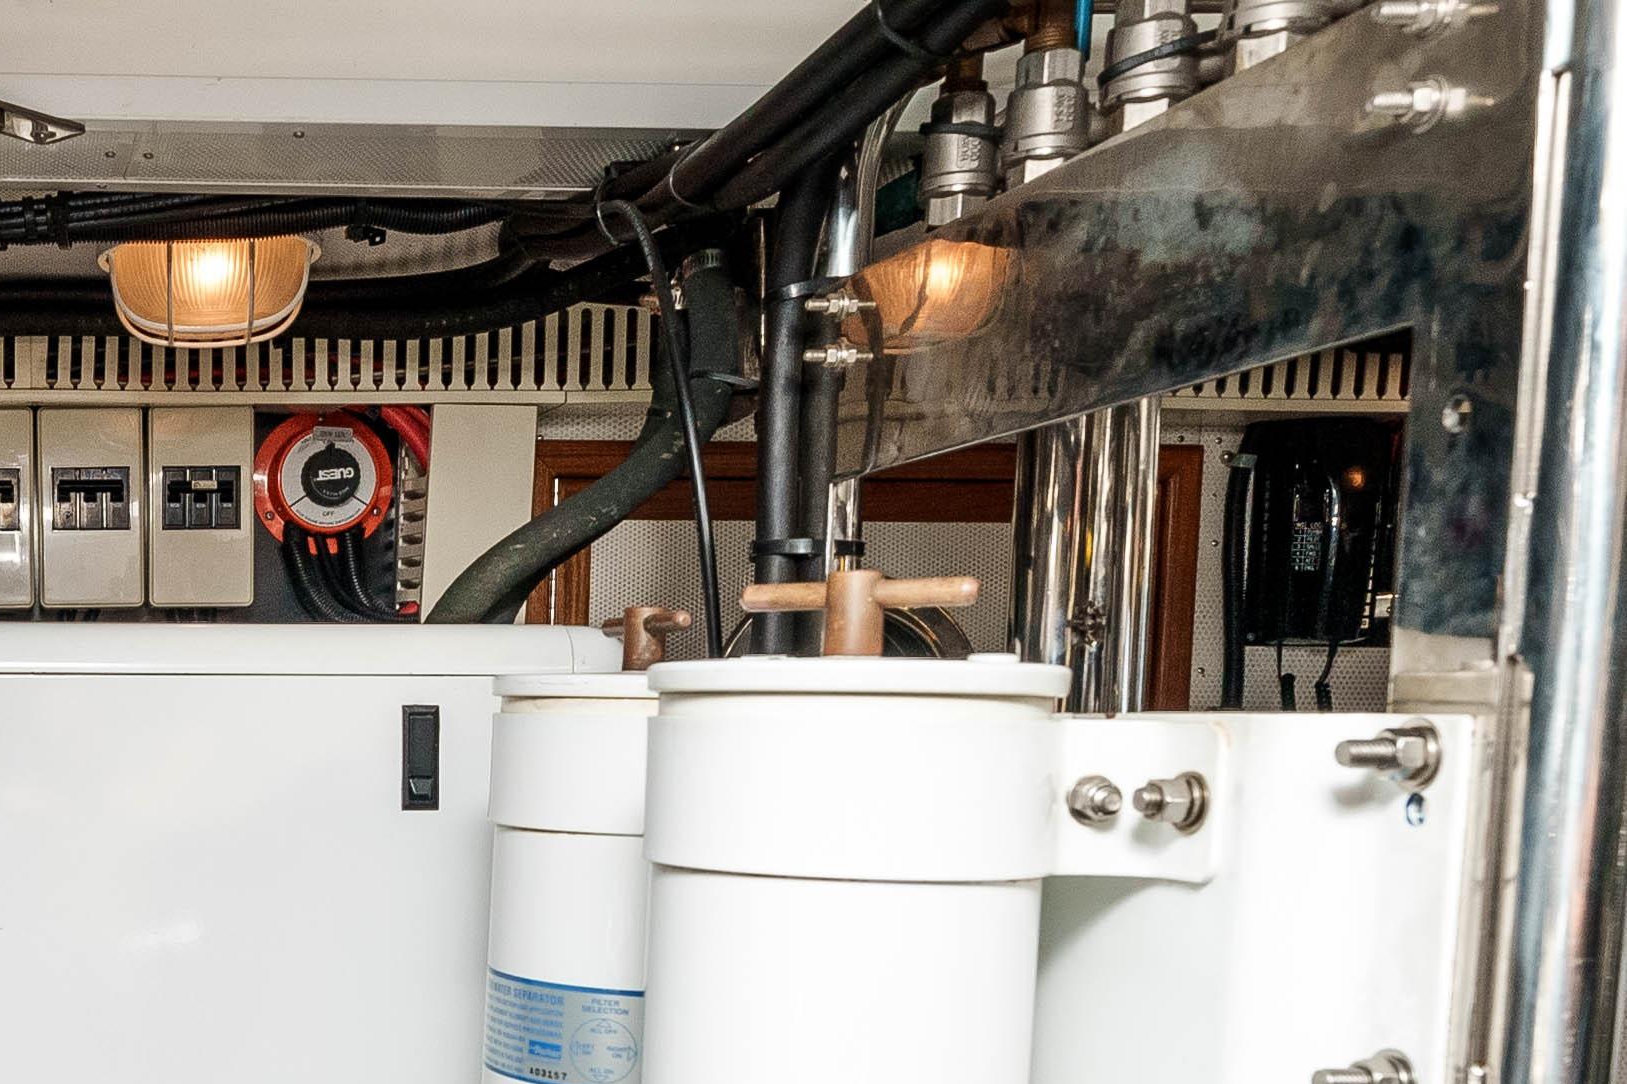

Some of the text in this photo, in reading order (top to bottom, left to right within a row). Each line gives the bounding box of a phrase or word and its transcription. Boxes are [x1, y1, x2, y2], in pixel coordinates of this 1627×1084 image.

[316, 467, 355, 481] GUEST
[512, 986, 566, 1006] SEPARATOR
[590, 998, 621, 1006] FILTER
[581, 1005, 630, 1016] SELECTION
